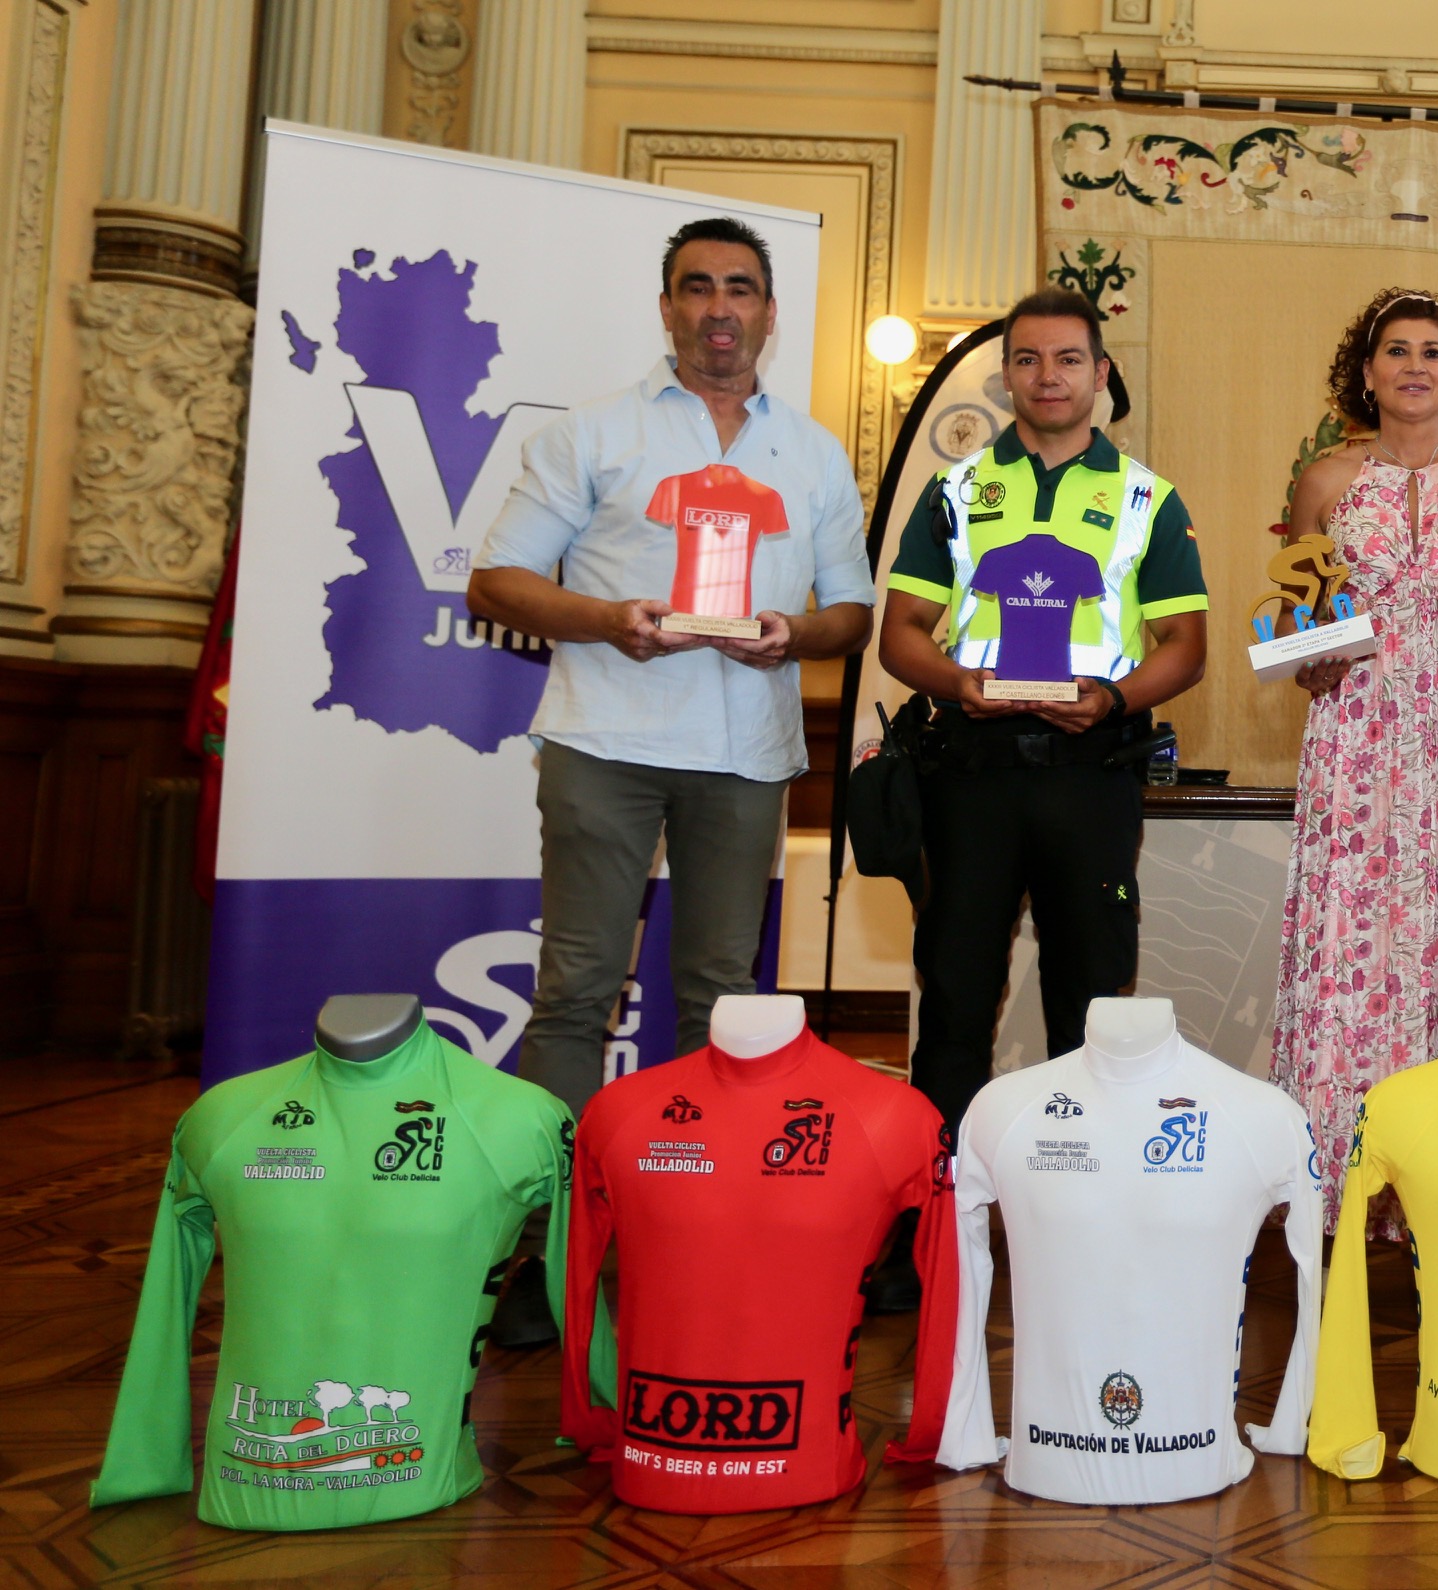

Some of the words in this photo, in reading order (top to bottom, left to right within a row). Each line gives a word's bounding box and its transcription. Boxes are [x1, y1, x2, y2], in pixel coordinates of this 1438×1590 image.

[688, 510, 747, 528] LORD
[1006, 597, 1031, 607] CAJA
[1034, 598, 1067, 608] RURAL
[257, 1148, 282, 1156] VUELTA
[1035, 1140, 1060, 1149] VUELTA
[1061, 1142, 1090, 1150] CICLISTA
[244, 1165, 325, 1179] VALLADOLID
[638, 1159, 715, 1174] VALLADOLID
[1027, 1157, 1100, 1172] VALLADOLID
[372, 1173, 389, 1181] Velo
[391, 1173, 408, 1181] Club
[410, 1174, 440, 1182] Delicias
[629, 1382, 791, 1441] LORD
[234, 1437, 289, 1461] RUTA
[298, 1444, 328, 1459] DEL
[336, 1425, 420, 1451] DUERO
[1029, 1424, 1106, 1453] DIPUTACIÓN
[1112, 1436, 1130, 1454] DE
[1135, 1428, 1216, 1454] VALLADOLID
[666, 1456, 702, 1475] BEER
[707, 1460, 717, 1476] &
[722, 1461, 749, 1475] GIN
[221, 1466, 248, 1484] POL.
[253, 1474, 270, 1488] LA
[272, 1476, 314, 1490] MORA
